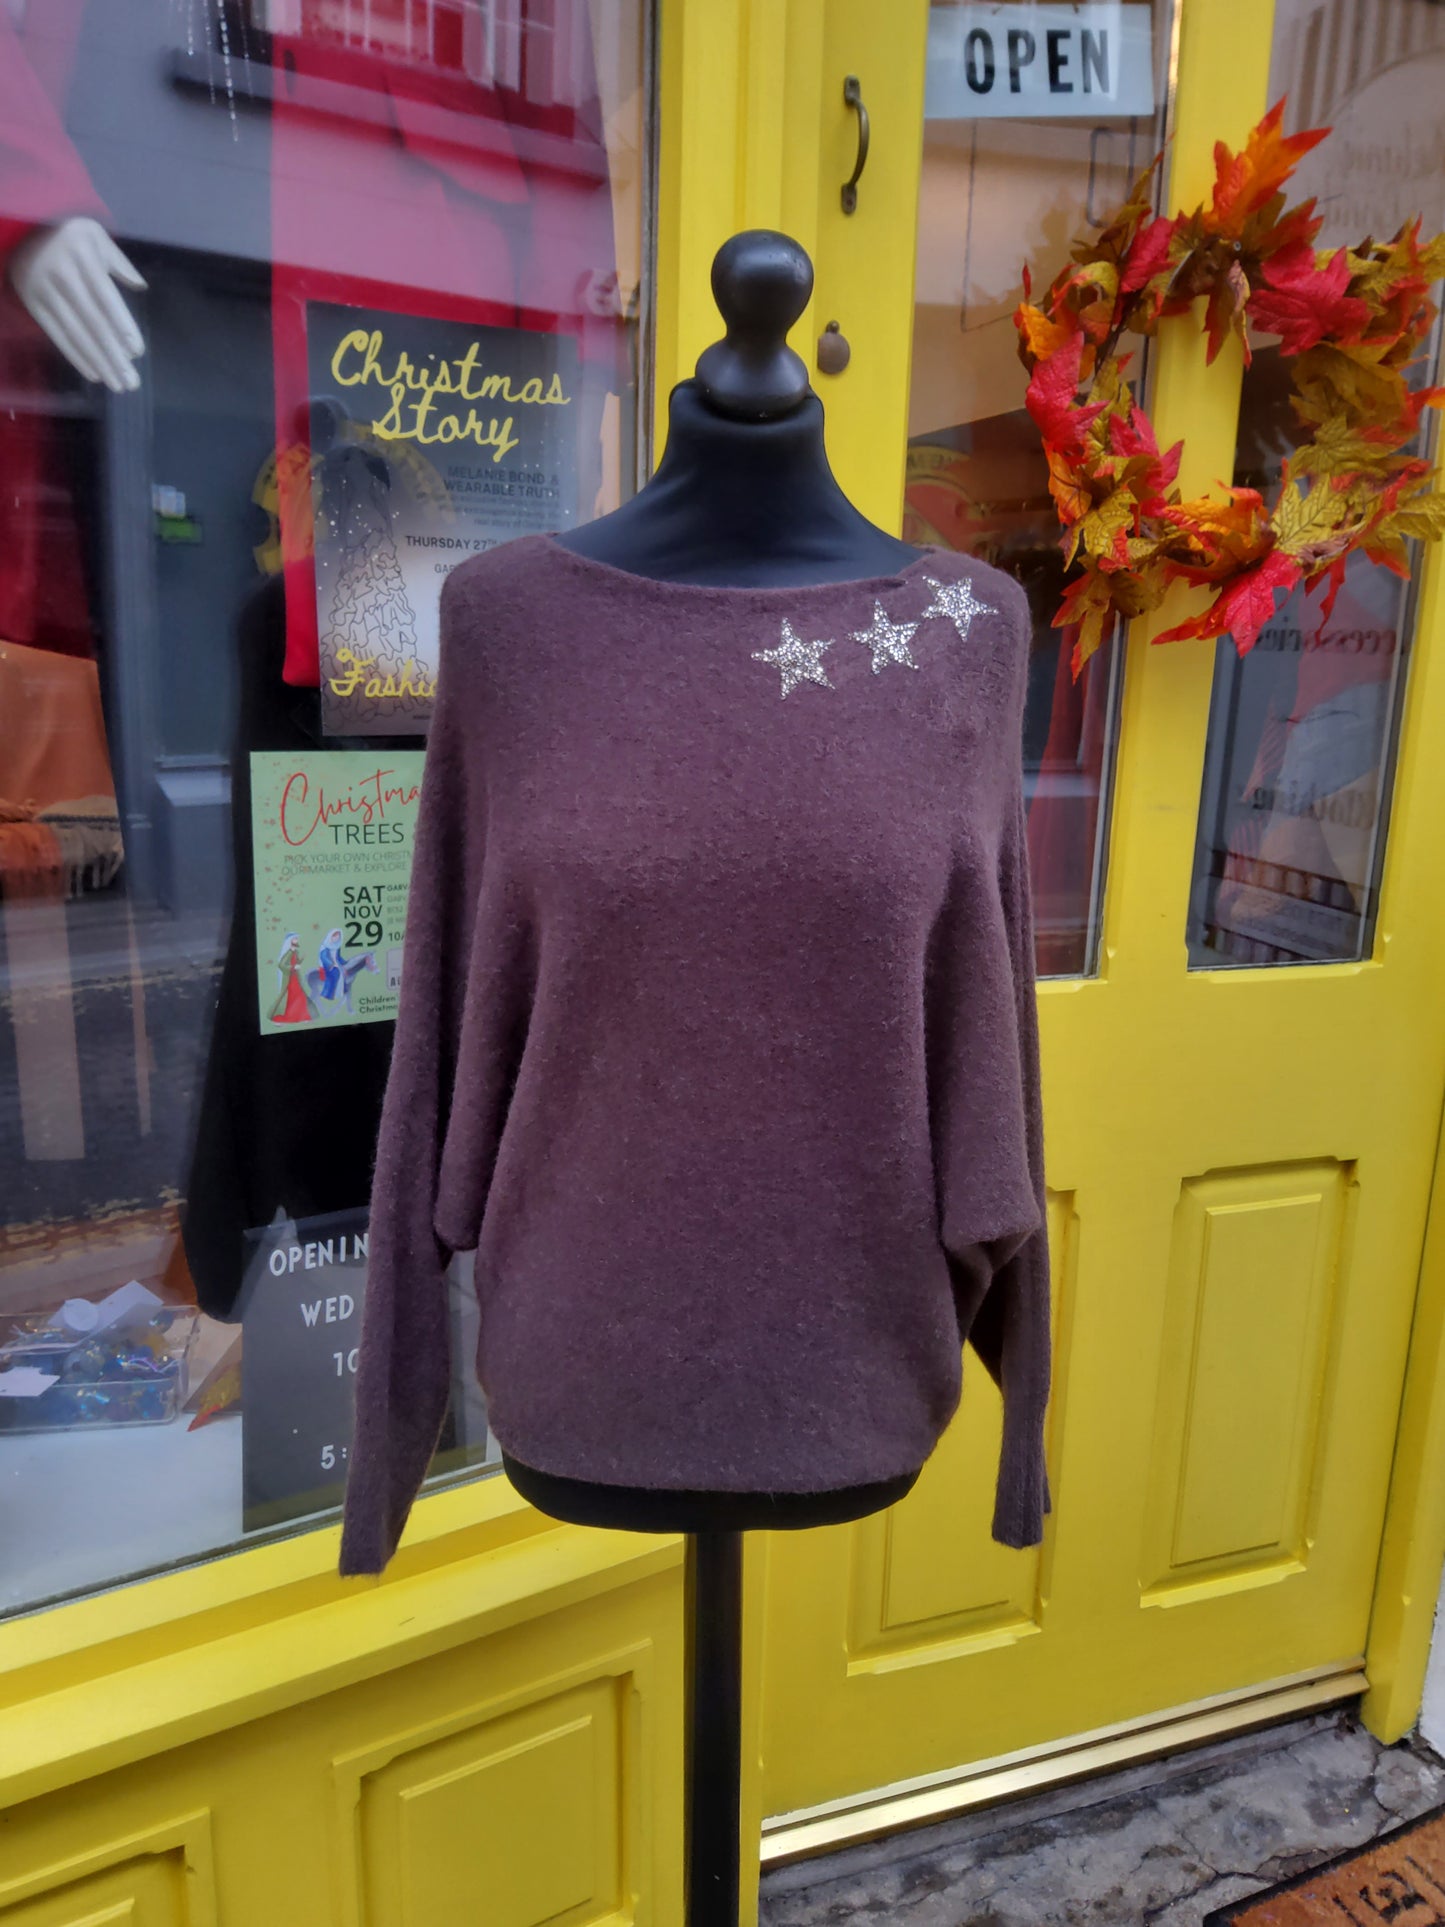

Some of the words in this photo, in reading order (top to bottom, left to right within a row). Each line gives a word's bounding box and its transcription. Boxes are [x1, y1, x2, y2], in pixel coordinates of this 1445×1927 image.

[964, 28, 1110, 94] OPEN
[331, 329, 571, 405] Christmas
[372, 382, 519, 462] Story
[447, 466, 505, 482] MELANIE
[509, 470, 545, 484] BOND
[443, 479, 515, 497] WEARABLE
[519, 485, 560, 498] TRUTH
[405, 535, 470, 550] THURSDAY
[329, 822, 405, 846] TREES
[281, 865, 304, 876] OUR
[309, 863, 350, 875] MARKET
[364, 861, 407, 873] EXPLORE
[284, 854, 307, 865] PICK
[311, 853, 341, 864] YOUR
[343, 852, 370, 863] OWN
[343, 885, 386, 904] SAT
[344, 905, 383, 920] NOV
[344, 921, 383, 948] 29
[269, 1233, 369, 1276] OPENIN
[301, 1295, 354, 1328] WED
